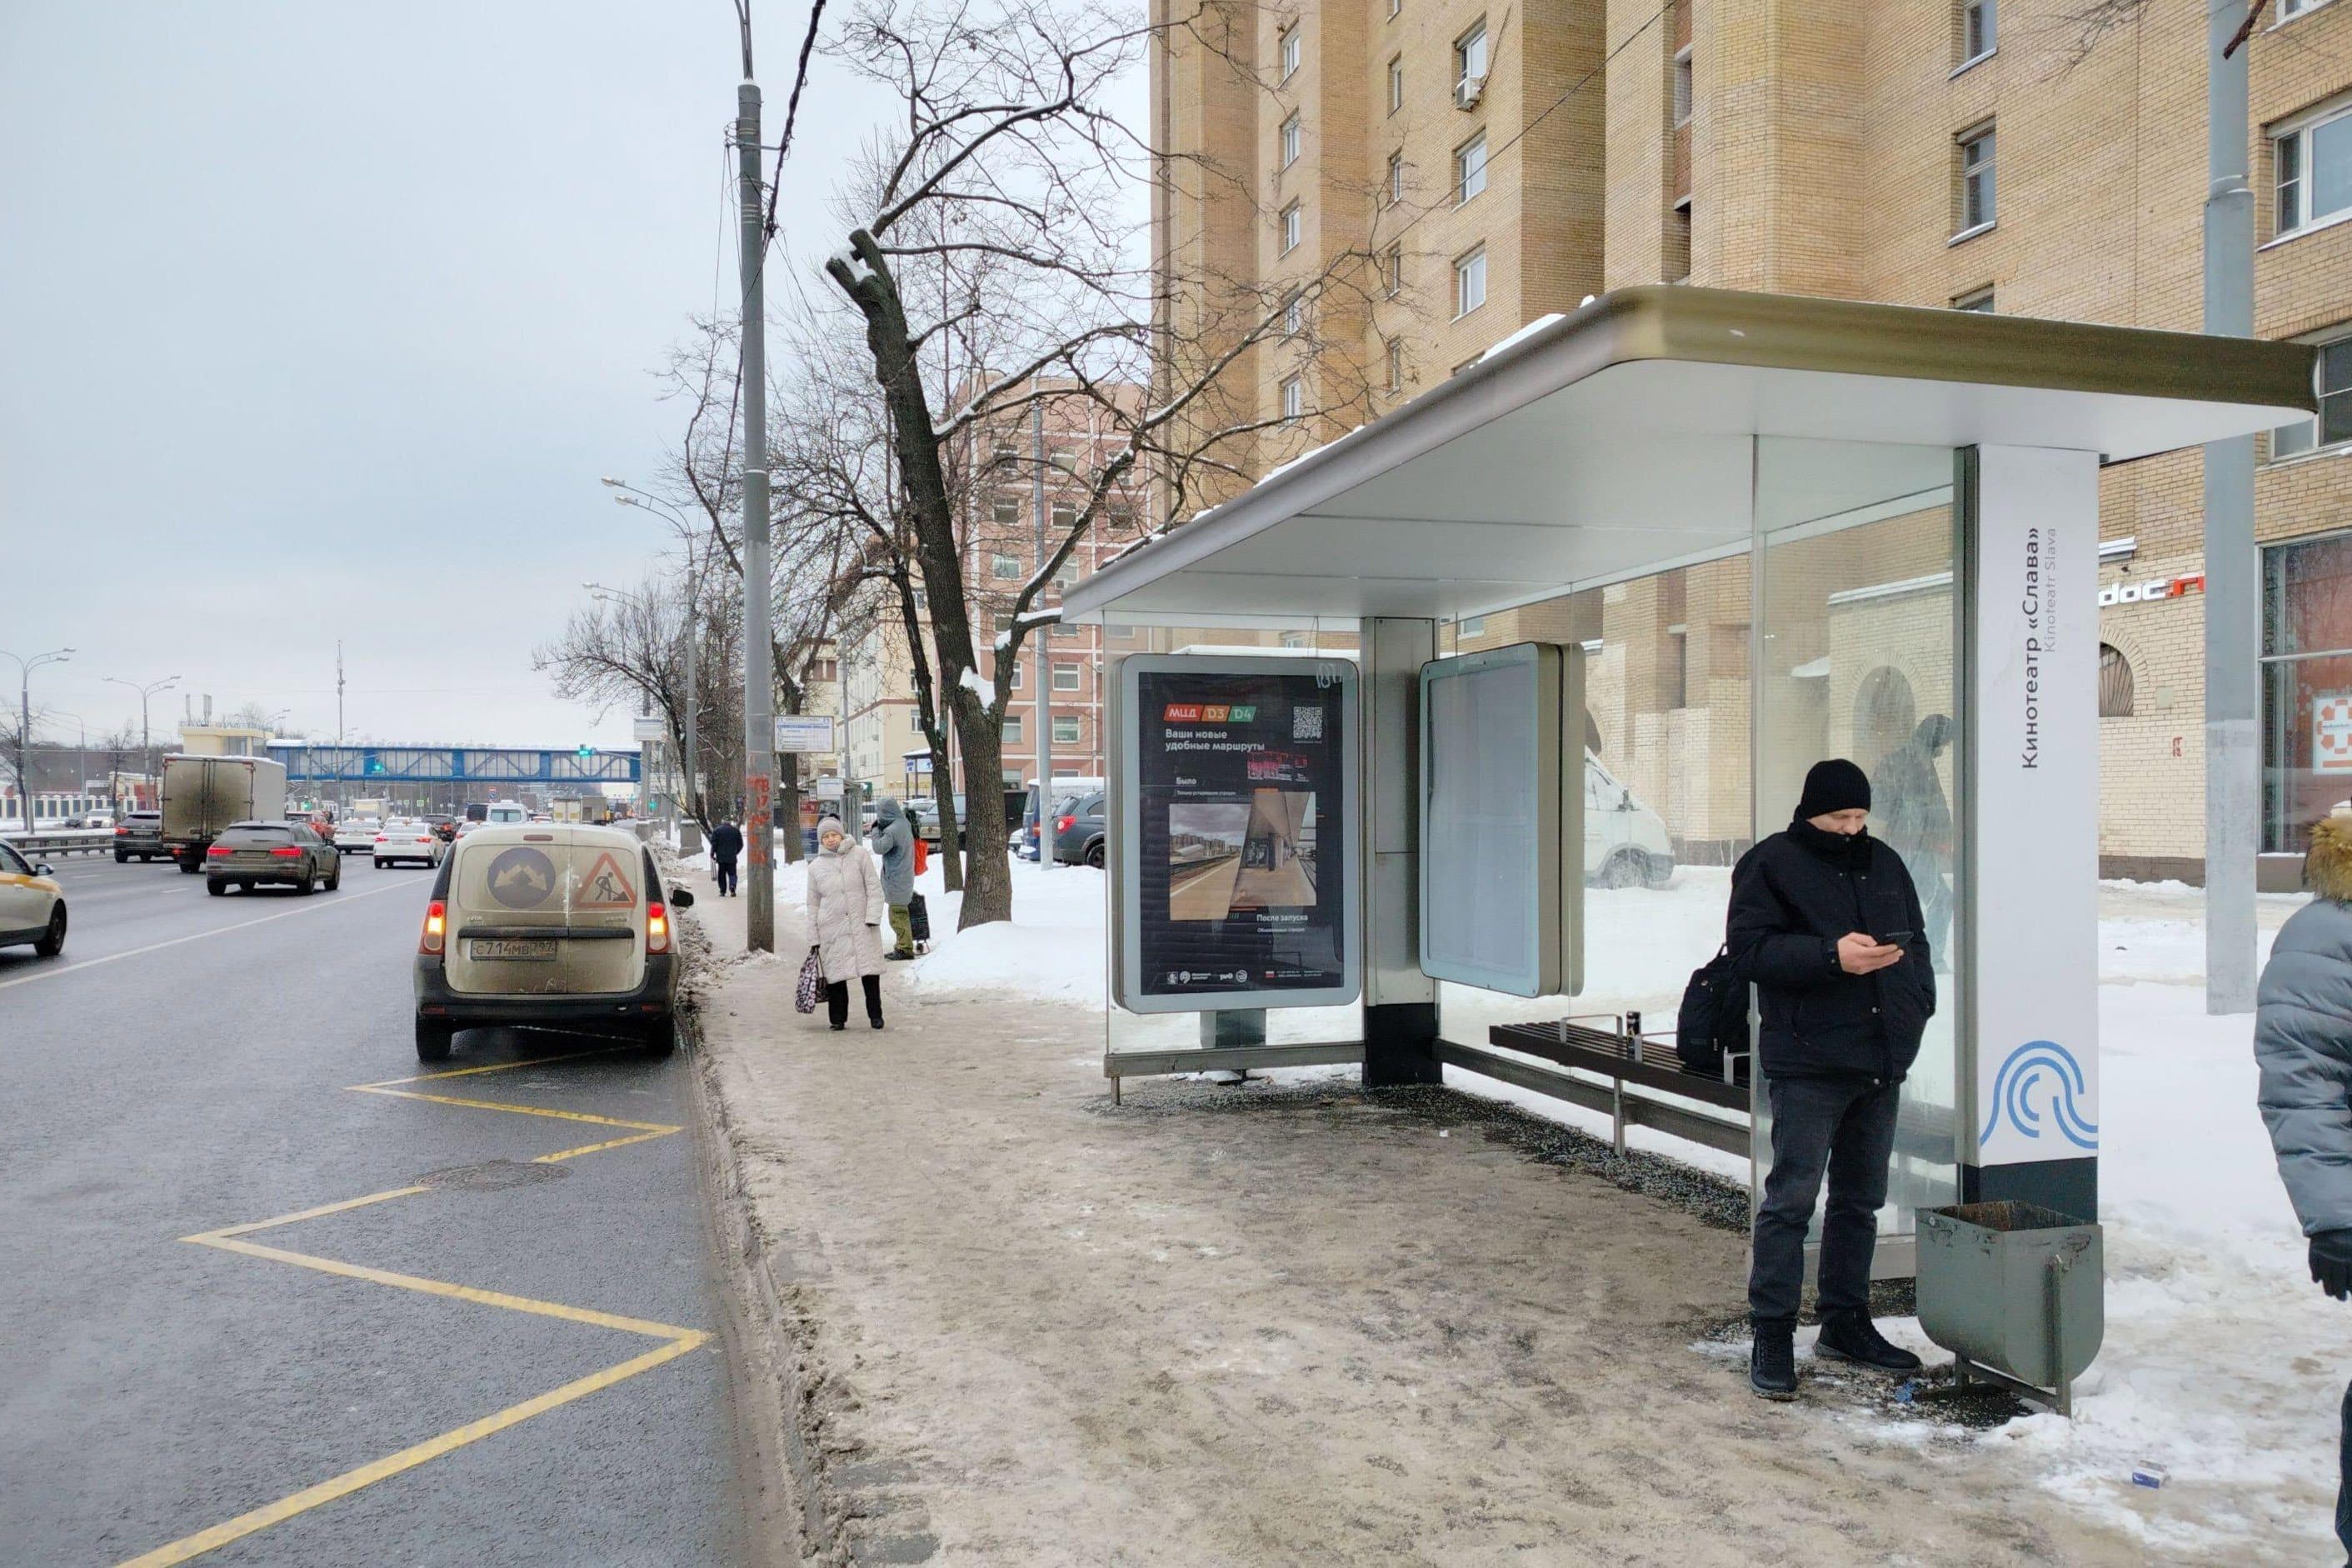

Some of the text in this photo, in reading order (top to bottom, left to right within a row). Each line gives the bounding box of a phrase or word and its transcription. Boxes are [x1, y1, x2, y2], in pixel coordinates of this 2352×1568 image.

[2044, 528, 2056, 652] Kinoteatr Slava
[2022, 527, 2042, 769] Кинотеатр «Слава»
[1169, 708, 1252, 720] МЦД D3 D4
[1166, 728, 1228, 739] Ваши новые
[1166, 740, 1266, 752] удобные маршруты
[1176, 777, 1197, 785] Было
[1256, 913, 1280, 921] После
